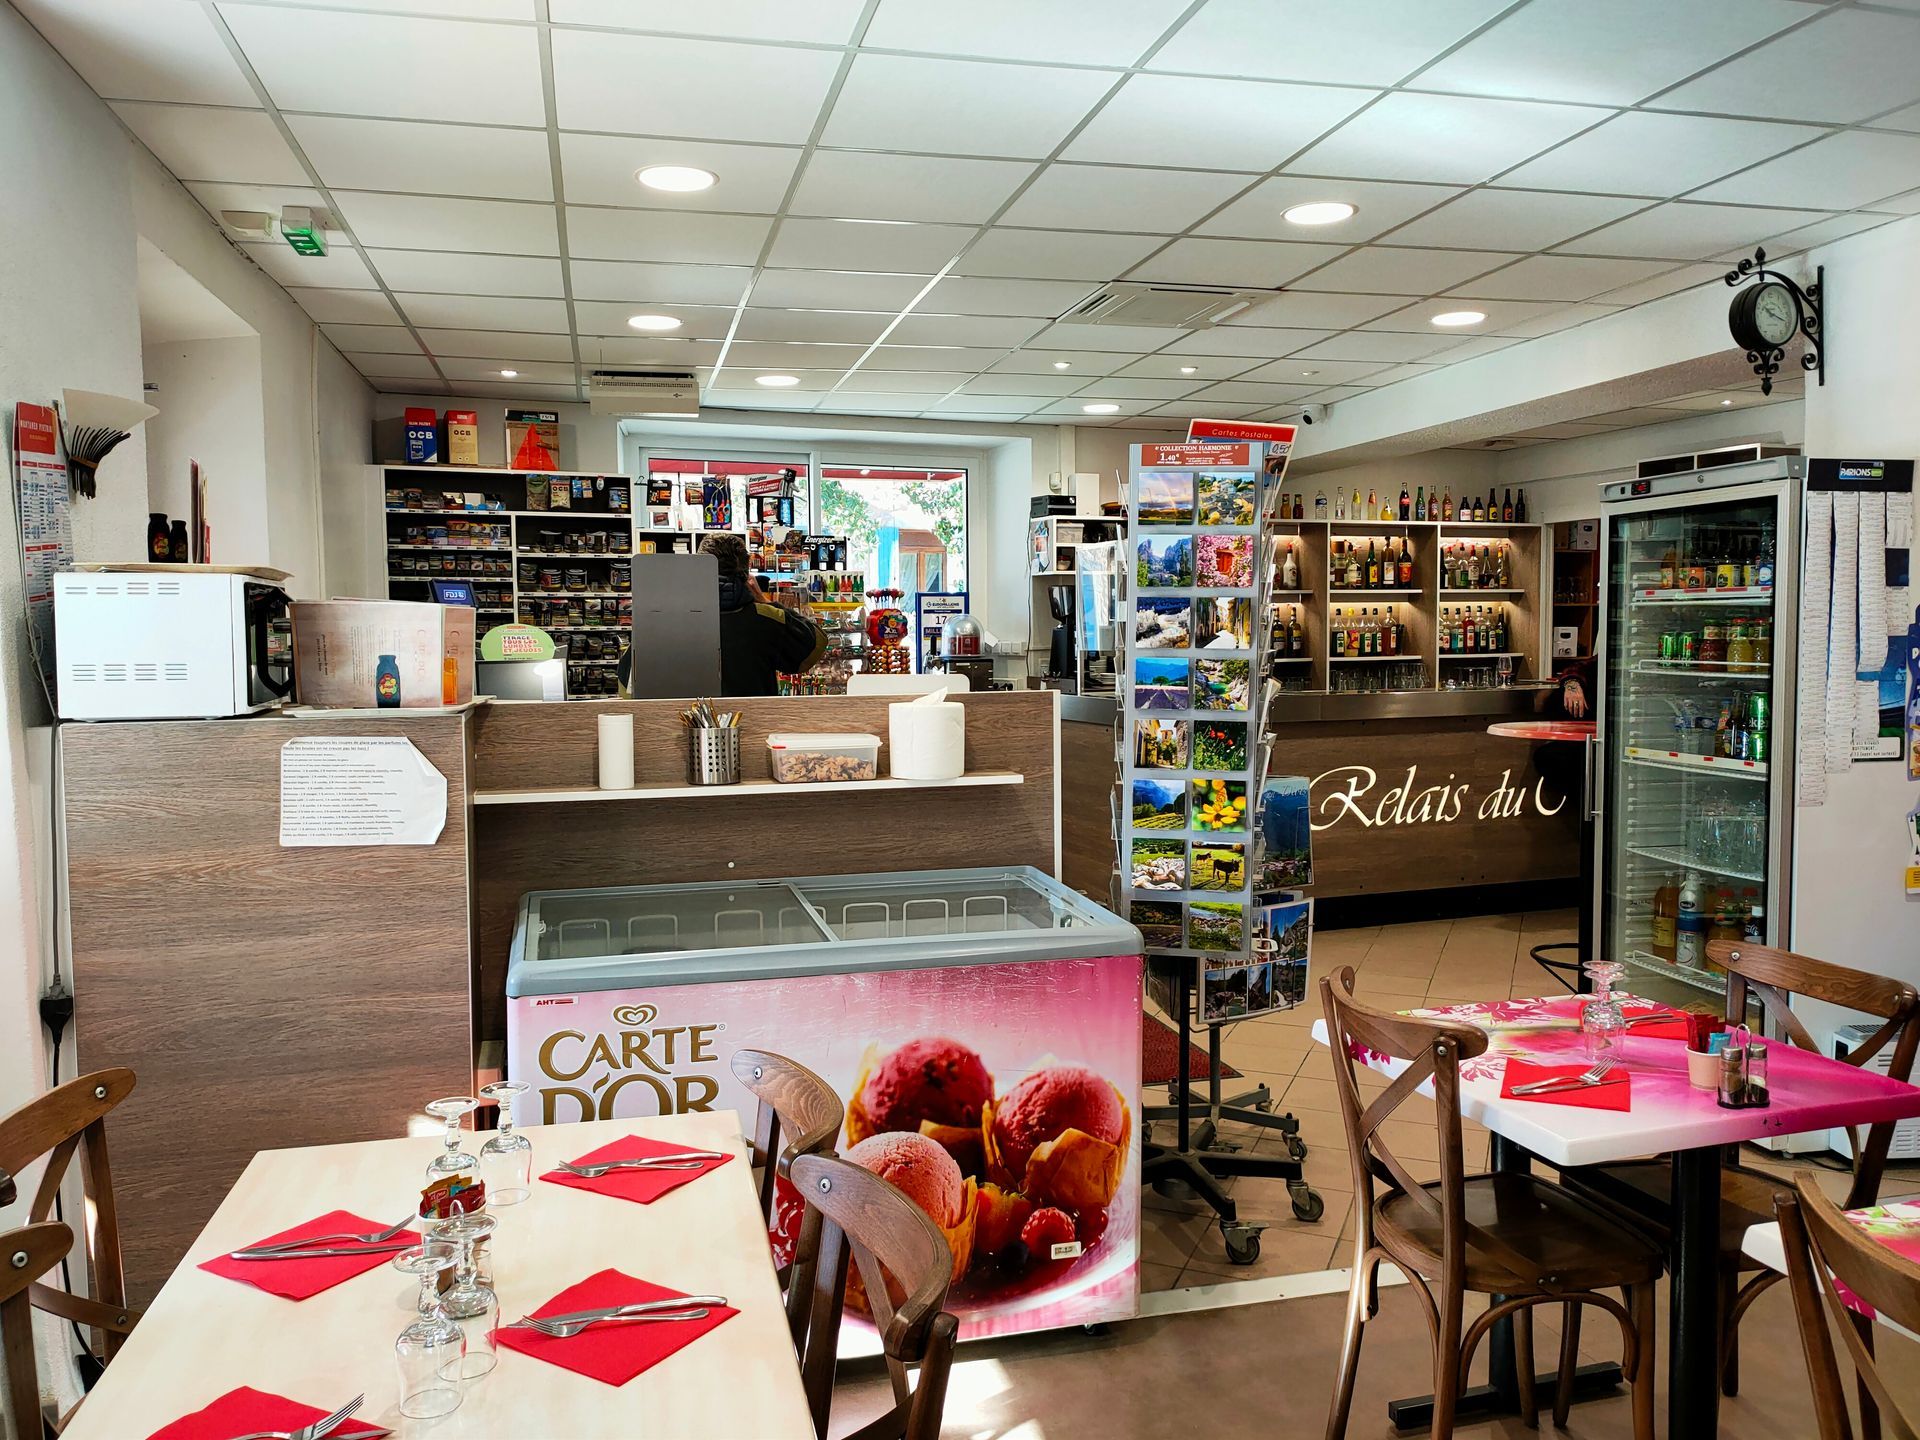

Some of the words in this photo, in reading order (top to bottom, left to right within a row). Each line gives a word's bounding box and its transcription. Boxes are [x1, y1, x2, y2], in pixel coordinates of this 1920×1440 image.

[408, 430, 433, 439] OCB
[1212, 428, 1238, 437] Cartes
[1240, 431, 1273, 439] Postales
[1840, 467, 1871, 477] PARIONS
[749, 475, 768, 483] Energizer
[804, 535, 834, 544] Energizer
[935, 615, 947, 625] 17
[1310, 765, 1470, 831] Relais
[1478, 769, 1526, 820] du
[538, 1024, 719, 1082] CARTE
[538, 1072, 720, 1127] D'OR
